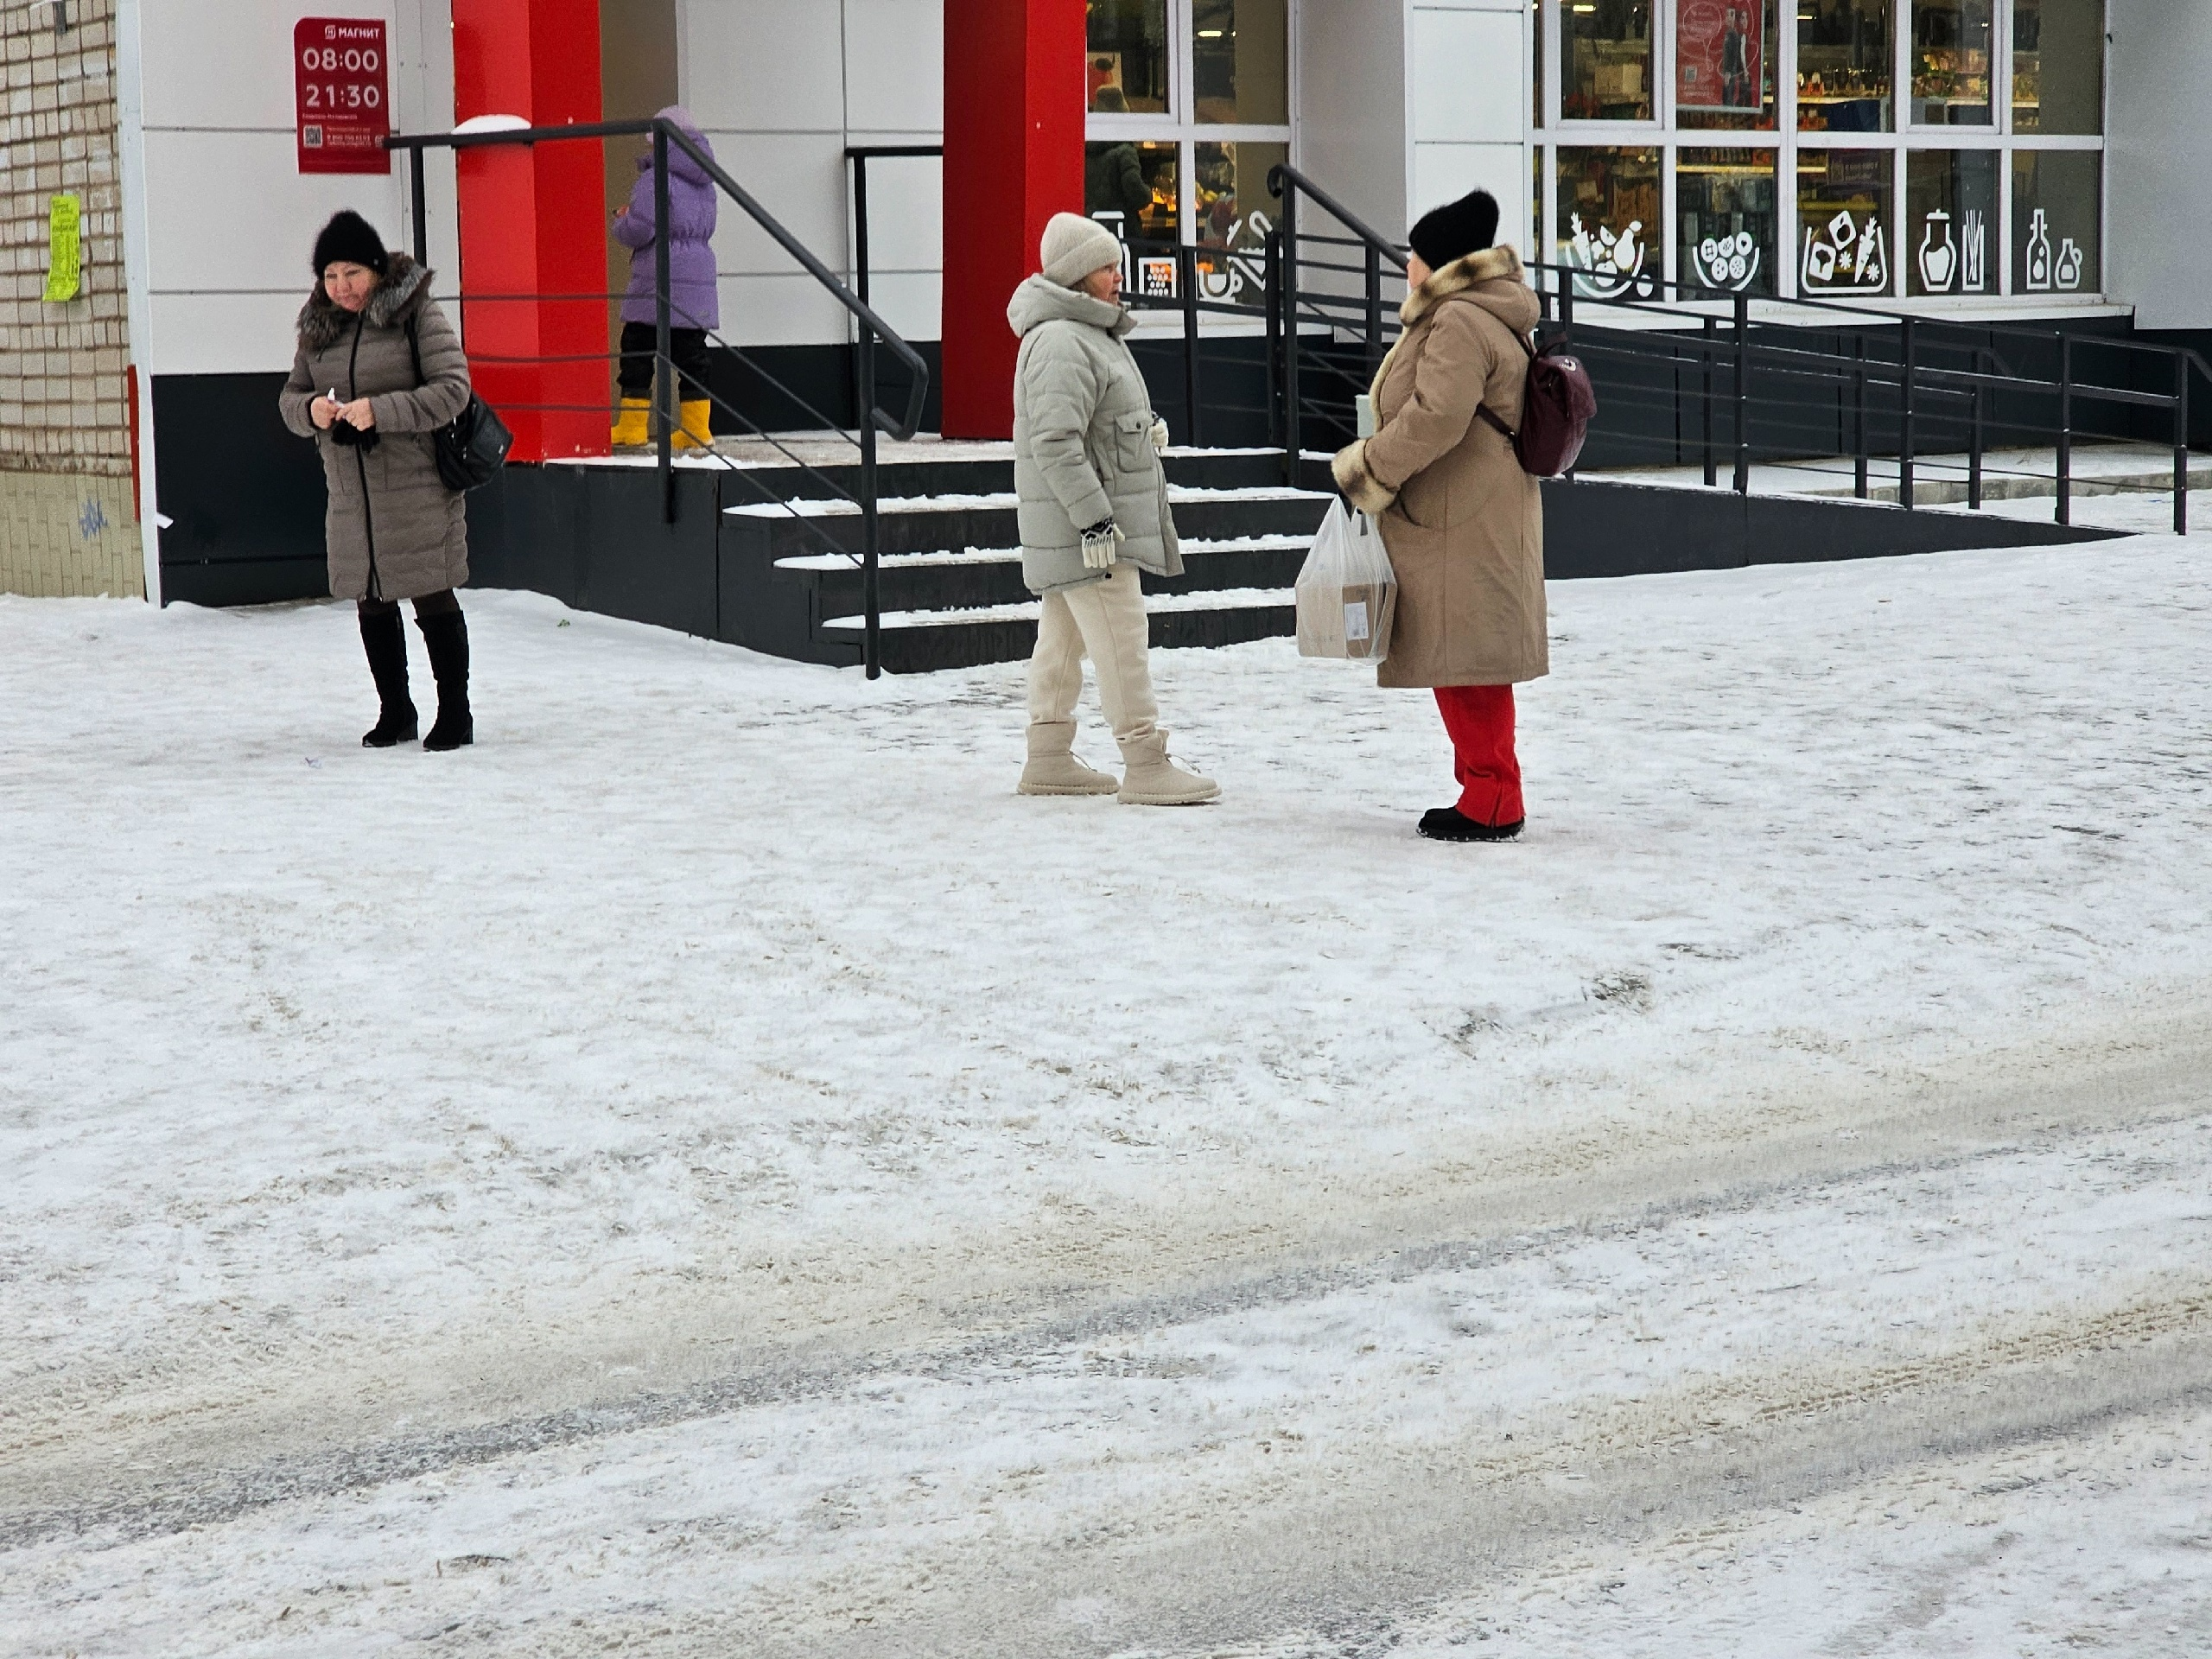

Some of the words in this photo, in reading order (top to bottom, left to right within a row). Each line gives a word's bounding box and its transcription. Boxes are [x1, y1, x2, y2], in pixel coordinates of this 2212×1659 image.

[339, 27, 380, 39] МАГНИТ
[303, 47, 378, 72] 08:00
[306, 84, 379, 108] 21:30
